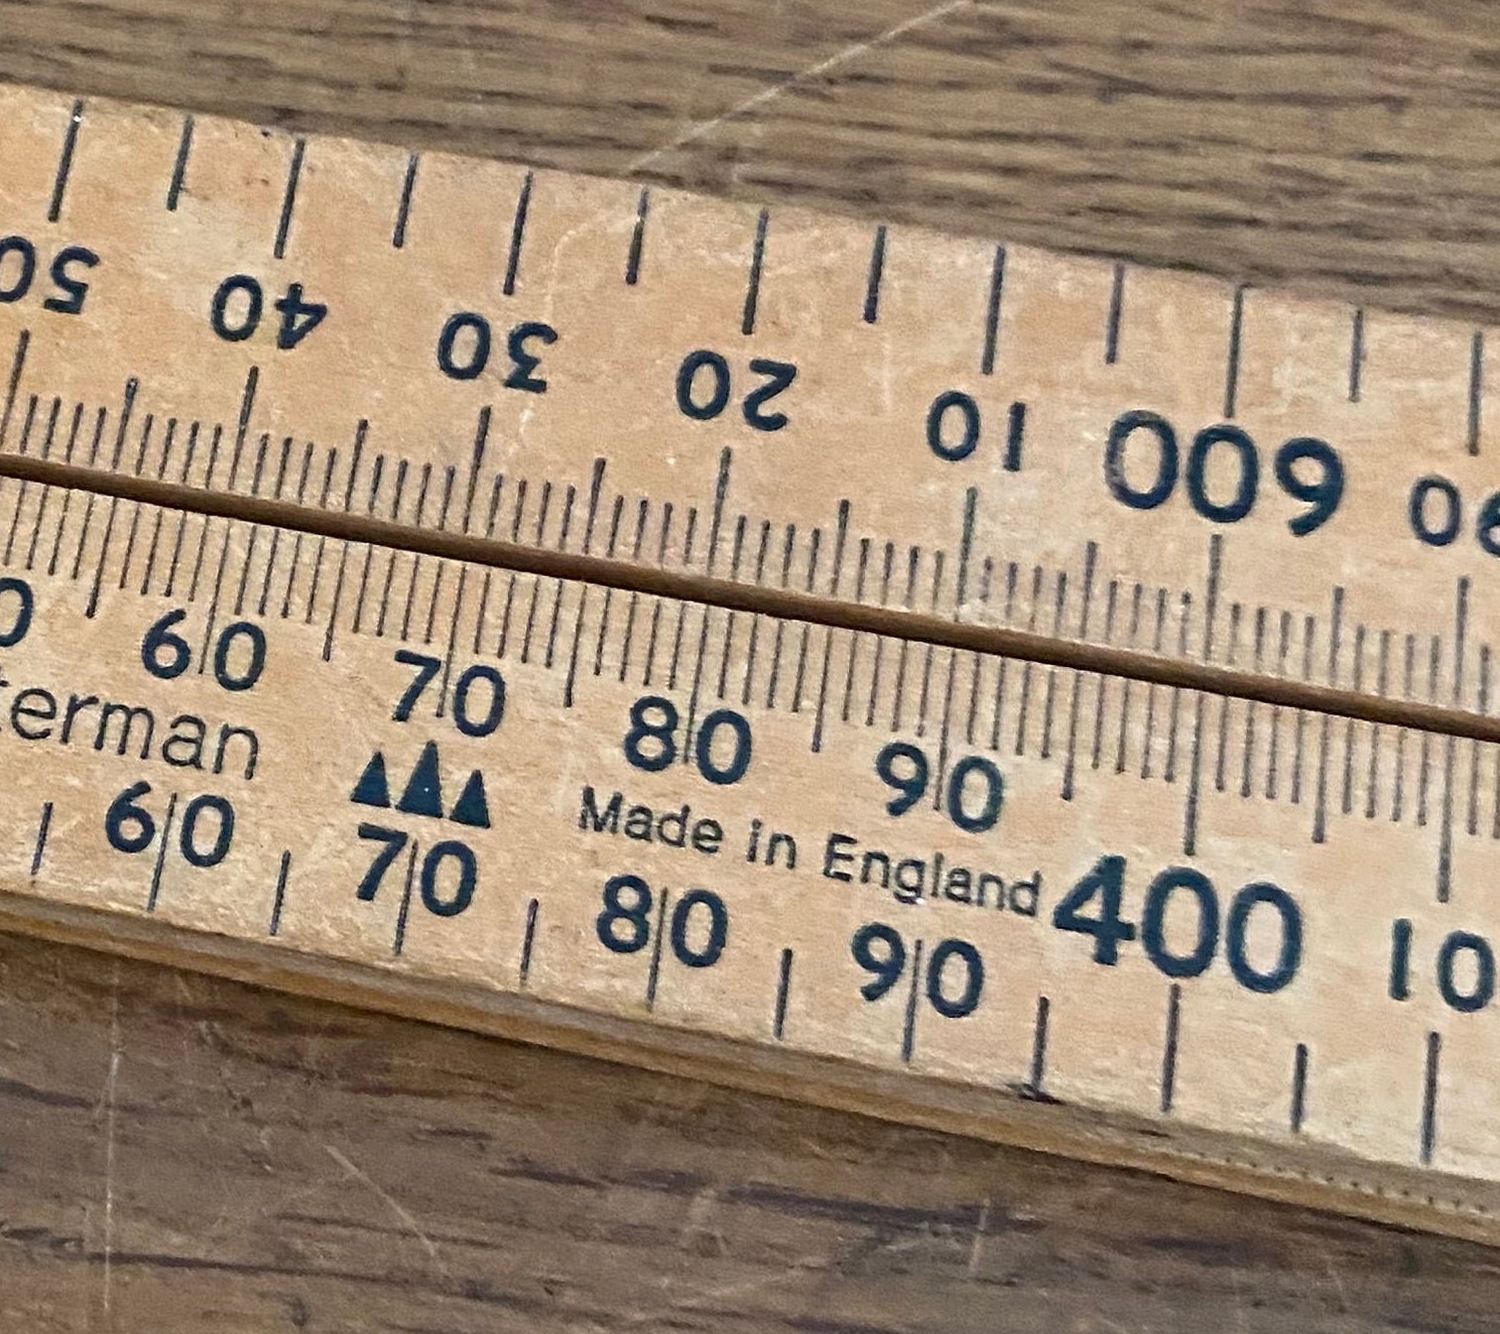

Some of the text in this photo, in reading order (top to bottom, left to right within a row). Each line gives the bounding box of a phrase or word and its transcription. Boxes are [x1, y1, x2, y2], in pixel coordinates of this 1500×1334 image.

[211, 274, 328, 350] 40
[437, 313, 559, 394] 30
[676, 350, 798, 432] 20
[926, 391, 1028, 472] 10
[1104, 409, 1346, 538] 600
[140, 610, 268, 692] 60
[392, 649, 507, 738] 70
[625, 696, 753, 786] 80
[875, 741, 1005, 834] 90
[1053, 854, 1302, 994] 400
[1389, 918, 1496, 1014] 10
[578, 787, 1044, 918] Made in England
[104, 780, 236, 868] 60
[355, 822, 478, 917] 70
[594, 874, 728, 968] 80
[850, 922, 986, 1019] 90
